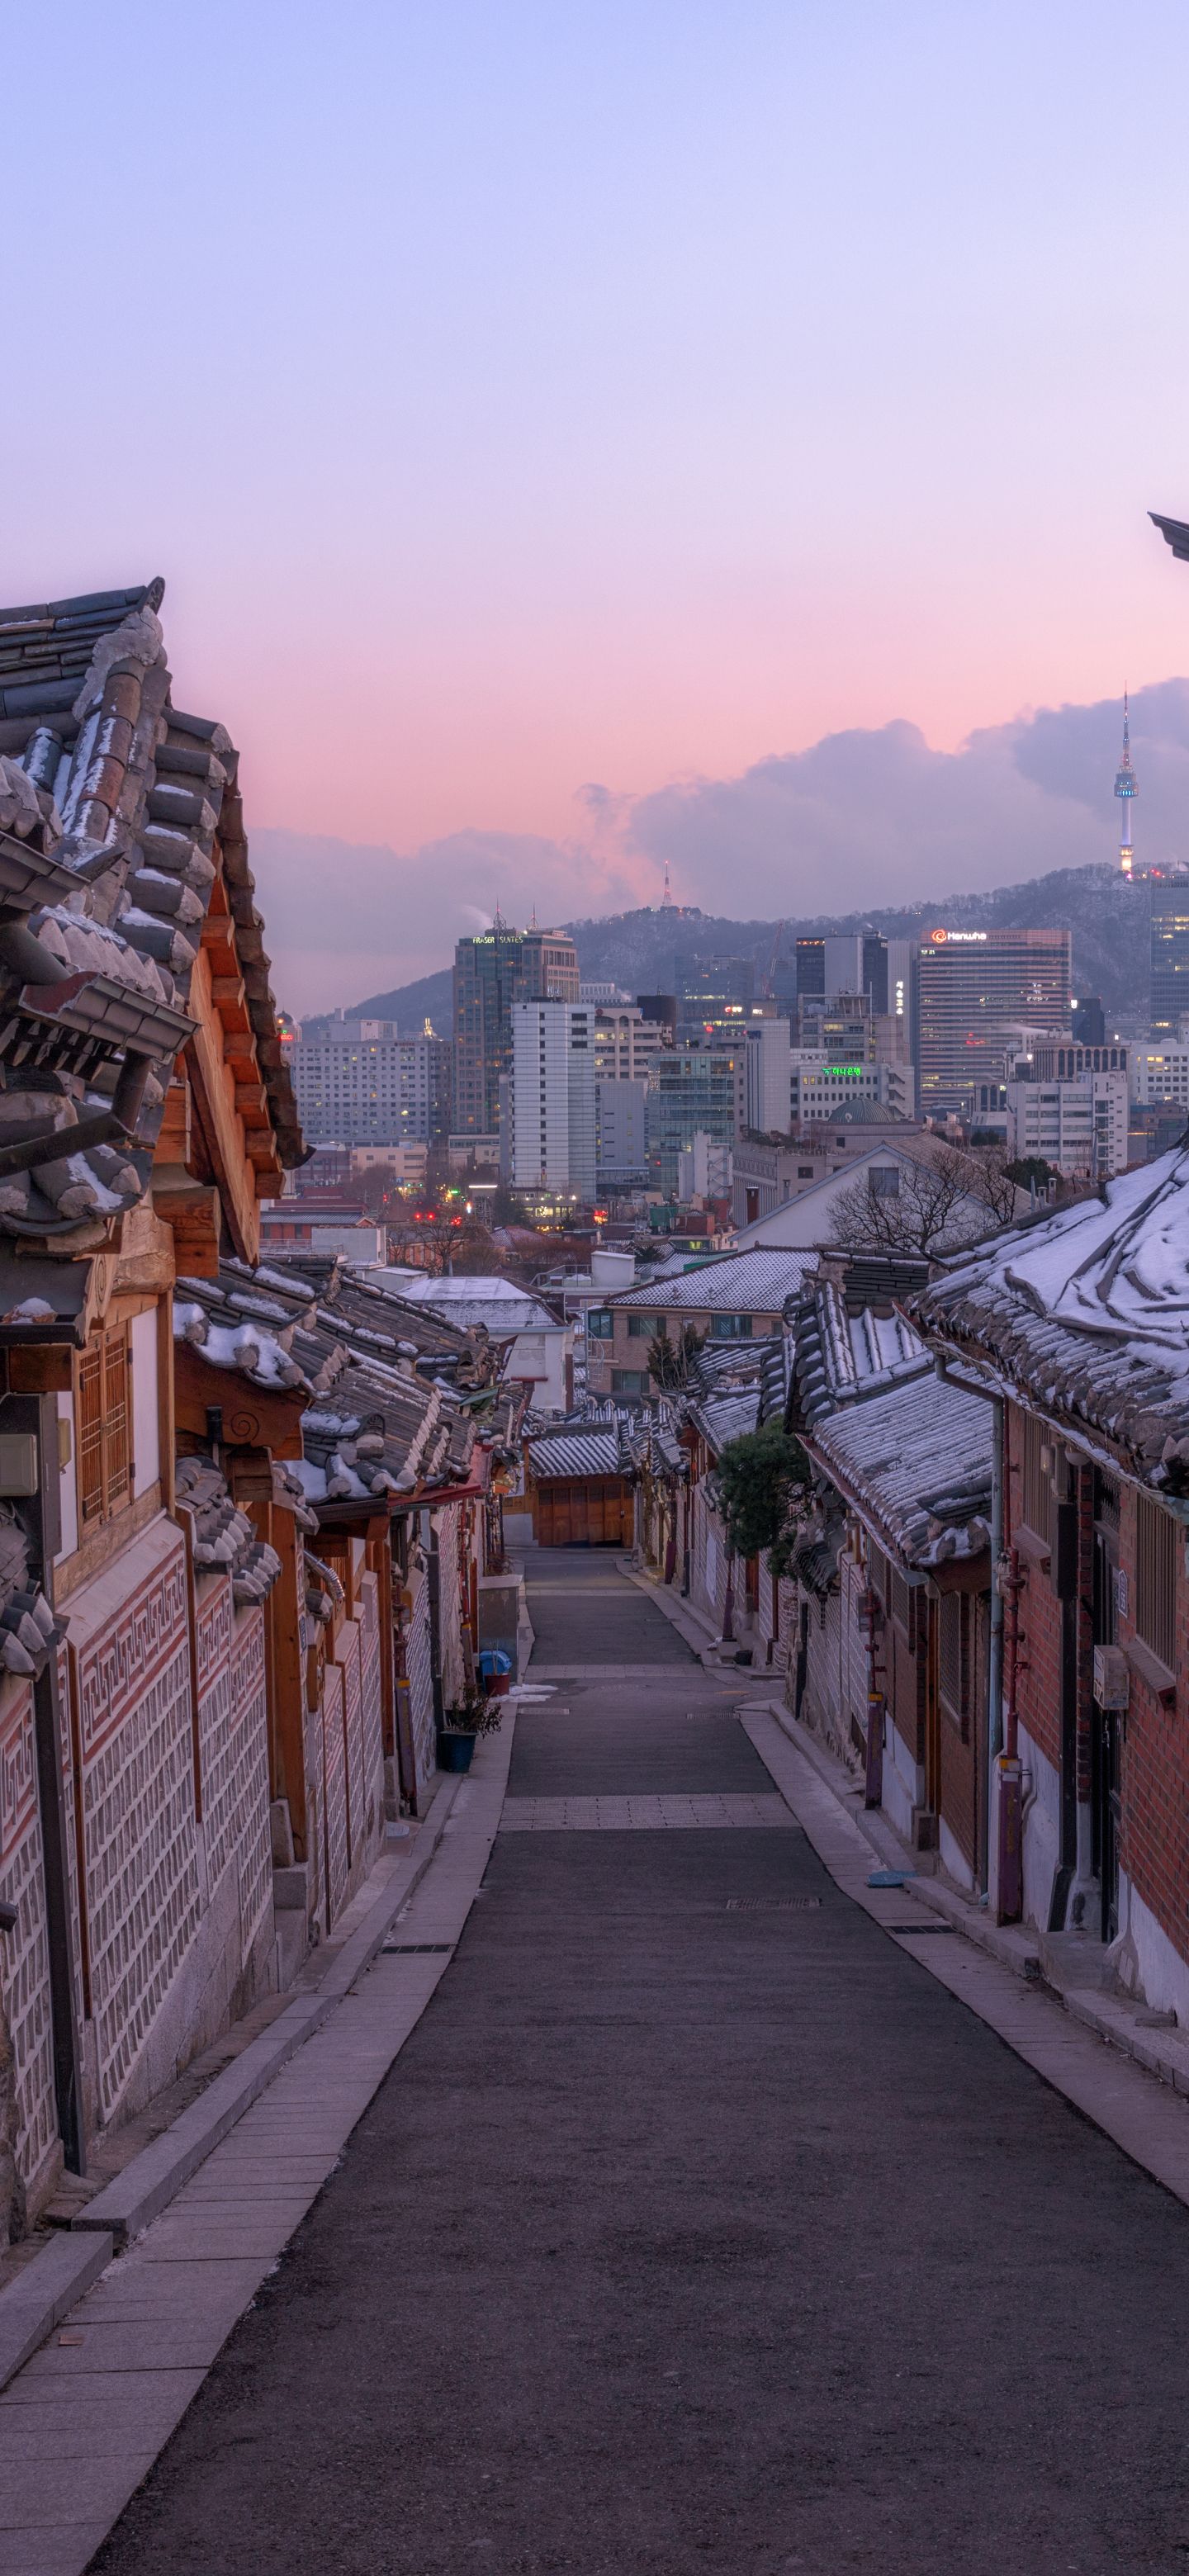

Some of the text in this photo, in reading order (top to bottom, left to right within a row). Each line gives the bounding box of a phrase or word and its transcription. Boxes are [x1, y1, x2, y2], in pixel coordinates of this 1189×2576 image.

[500, 935, 523, 944] SUITES
[947, 932, 987, 940] Hanwha
[831, 1068, 860, 1076] 하나은행
